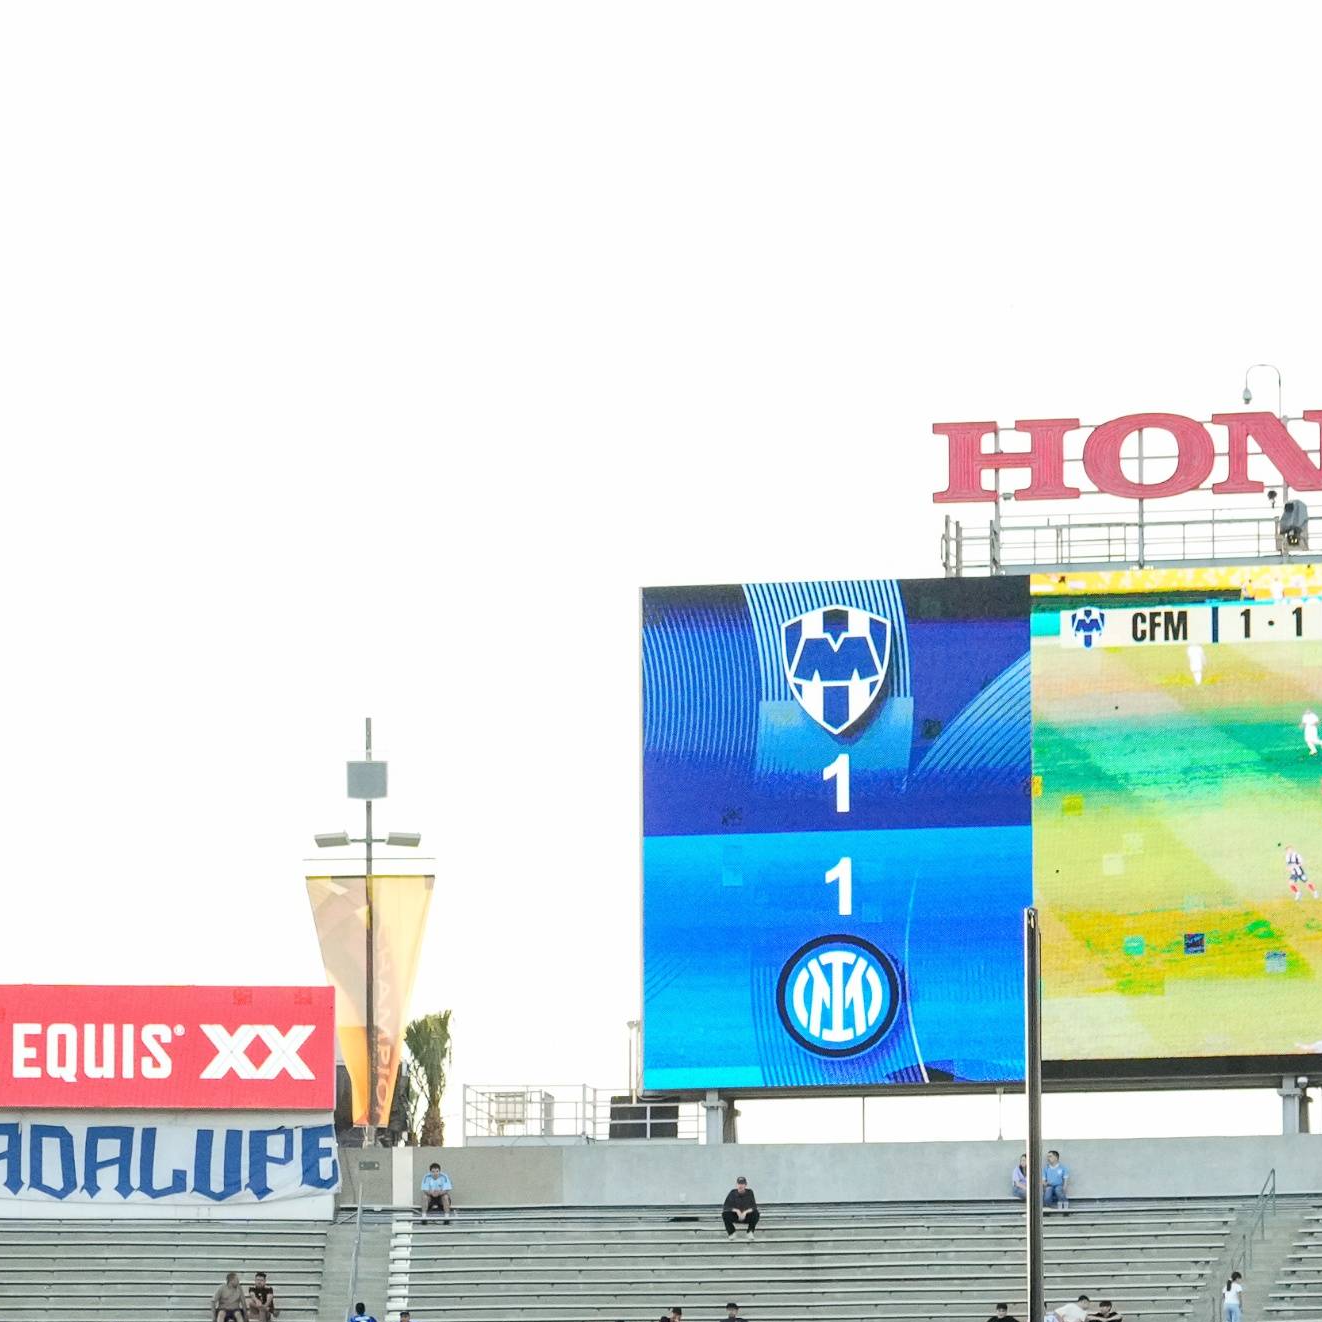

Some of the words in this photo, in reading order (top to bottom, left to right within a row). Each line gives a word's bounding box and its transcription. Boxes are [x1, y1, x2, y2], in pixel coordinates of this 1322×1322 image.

[1131, 610, 1188, 641] CFM
[1239, 608, 1252, 639] 1
[1291, 606, 1304, 637] 1
[822, 753, 851, 812] 1
[825, 856, 853, 916] 1
[199, 1023, 316, 1081] XX
